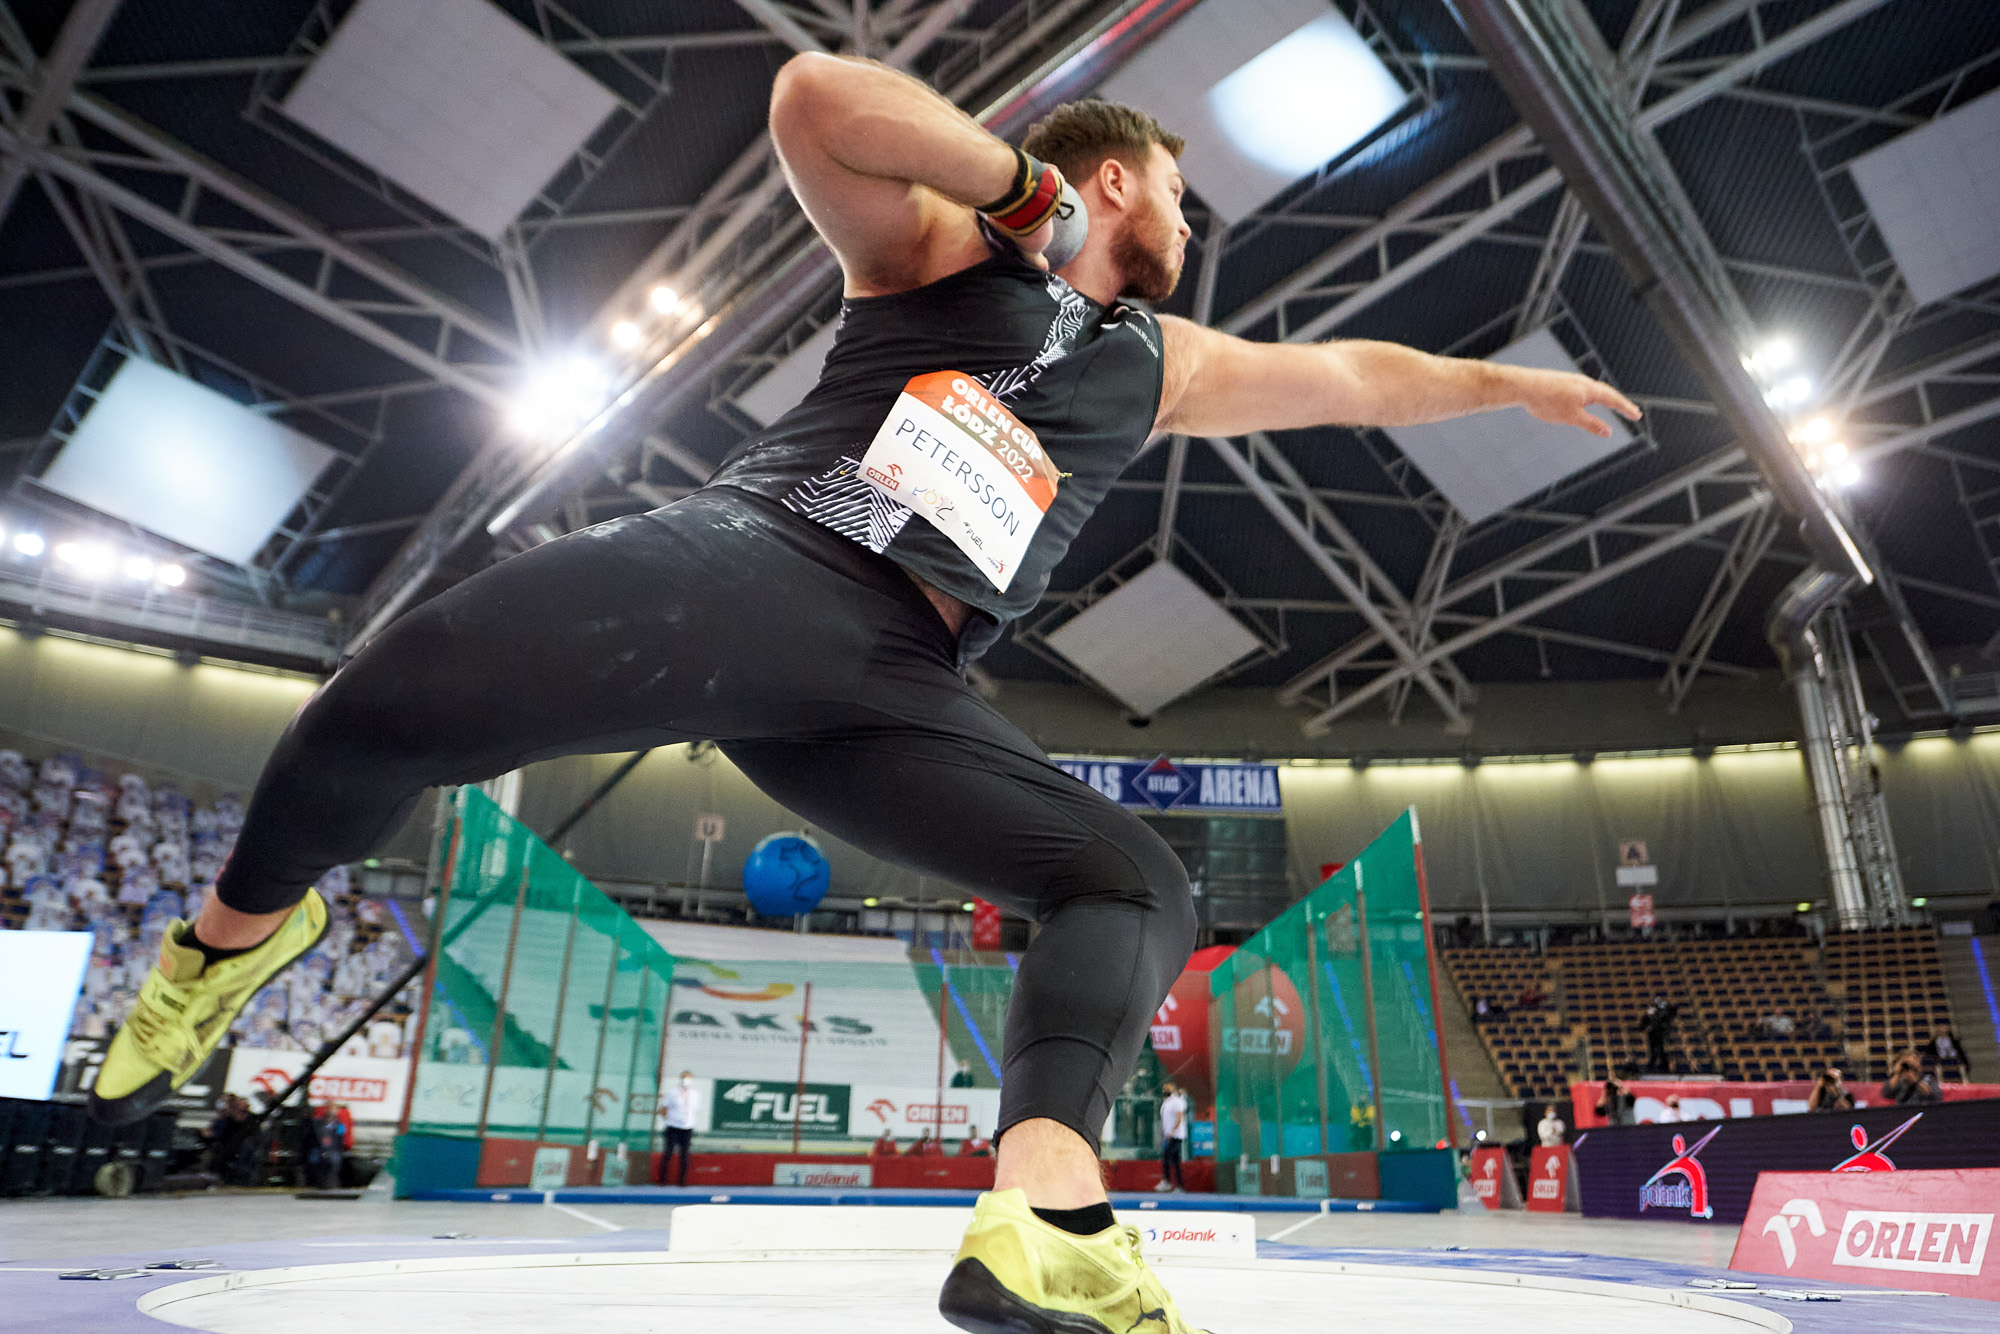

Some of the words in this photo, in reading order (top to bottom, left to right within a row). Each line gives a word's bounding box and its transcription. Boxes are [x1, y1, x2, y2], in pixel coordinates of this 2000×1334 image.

[941, 395, 999, 447] ŁÓDŹ
[996, 440, 1034, 484] 2022
[951, 378, 1013, 433] ORLEN
[1011, 427, 1043, 461] CUP
[868, 469, 899, 490] ORLEN
[895, 418, 1020, 537] PETERSSON
[1201, 768, 1279, 805] ARENA
[751, 1093, 840, 1123] FUEL
[1162, 1228, 1216, 1243] polanik
[1846, 1219, 1980, 1264] ORLEN
